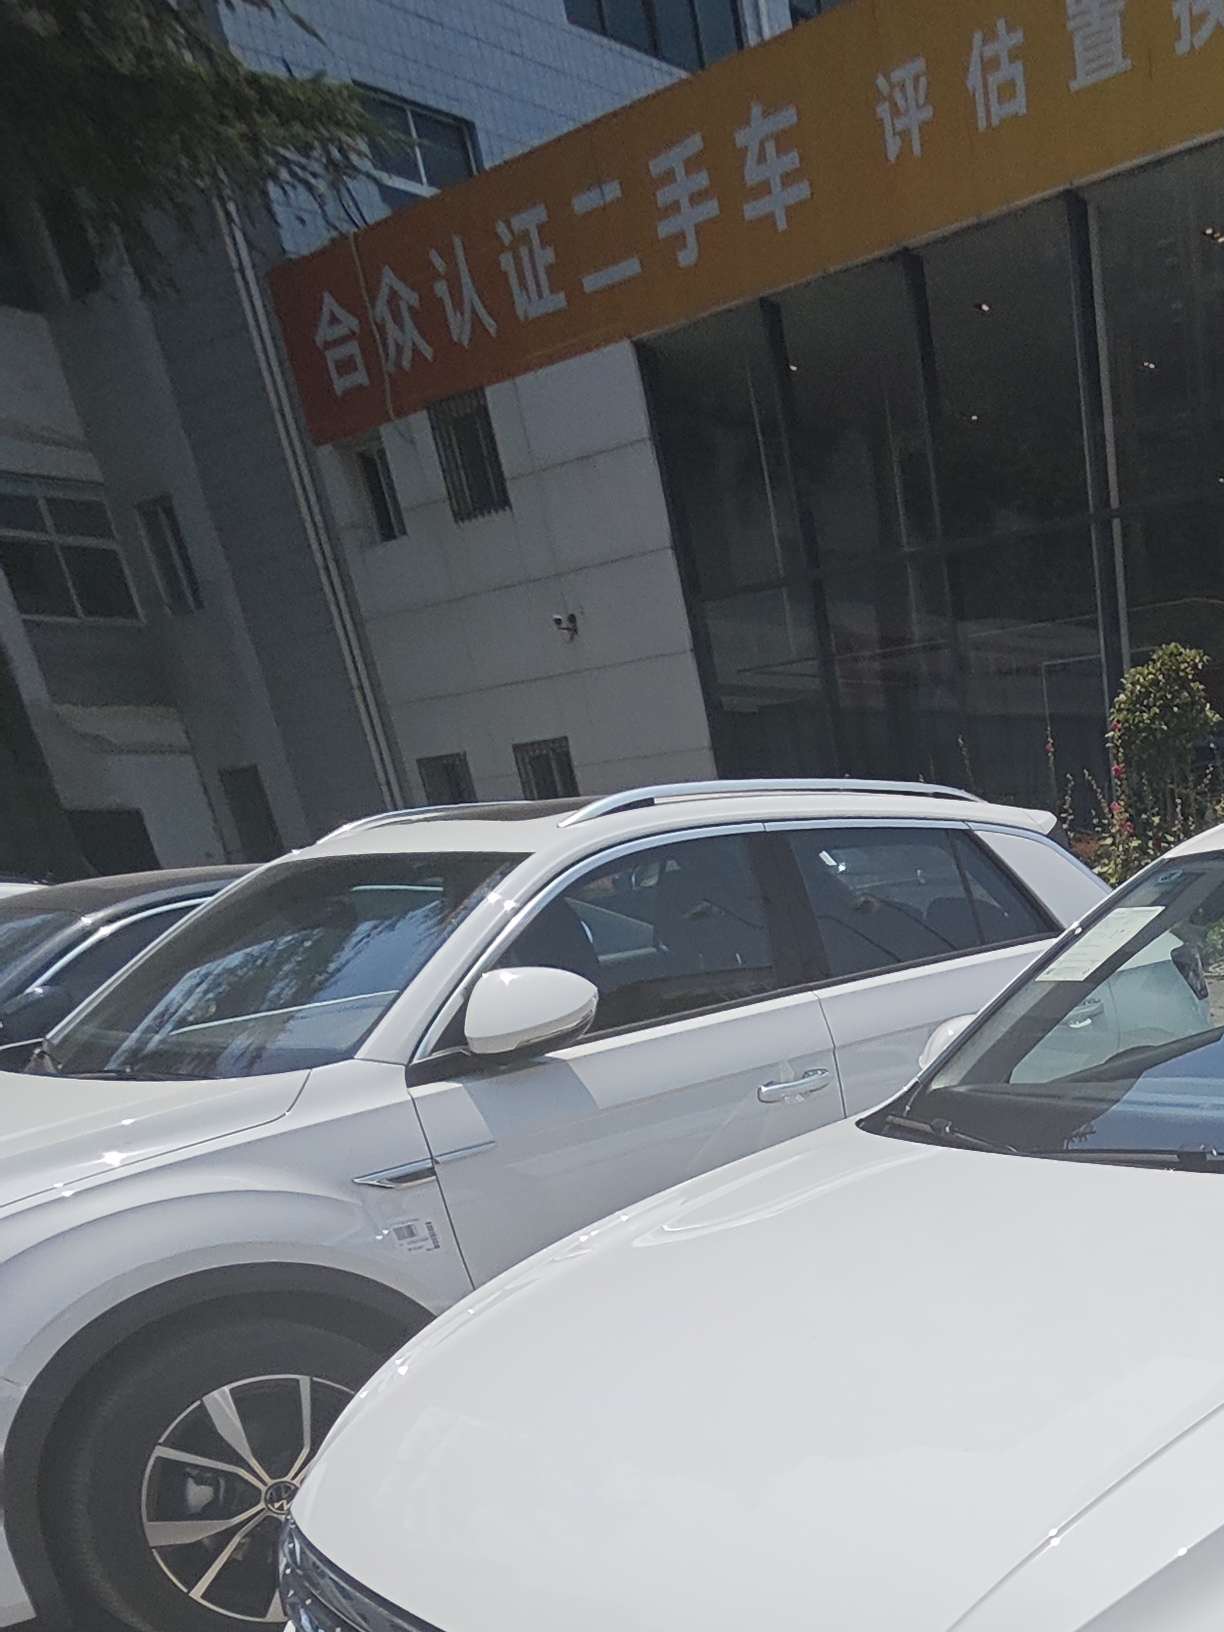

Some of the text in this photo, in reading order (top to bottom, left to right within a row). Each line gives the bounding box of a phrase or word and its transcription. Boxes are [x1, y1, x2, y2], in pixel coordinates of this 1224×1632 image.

[313, 101, 810, 397] 合众认证二手车
